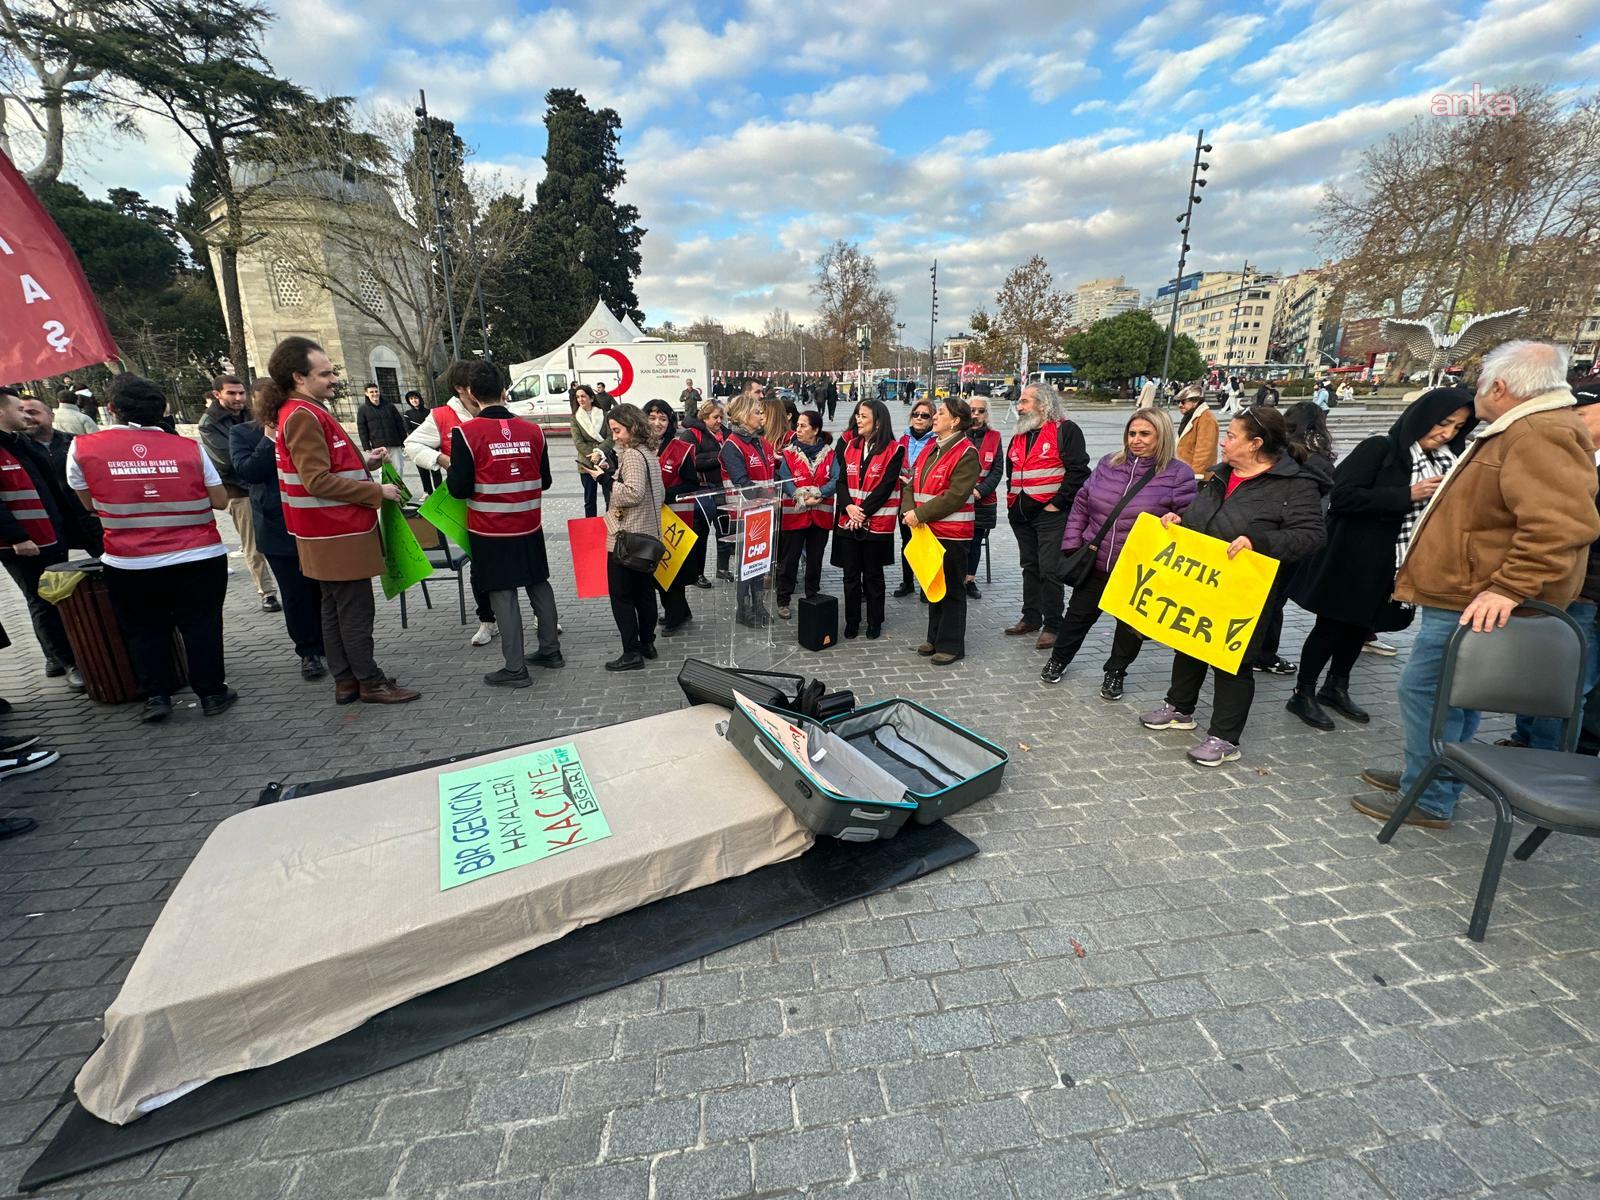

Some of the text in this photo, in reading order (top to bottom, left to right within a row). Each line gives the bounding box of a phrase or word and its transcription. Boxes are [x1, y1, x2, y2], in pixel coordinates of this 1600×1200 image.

[110, 466, 179, 475] HAKKINIZ VAR
[748, 541, 767, 558] CHP
[1153, 541, 1221, 588] ARTIK
[448, 782, 496, 875] BİR GENCİN
[487, 774, 528, 853] HAYALLERİ
